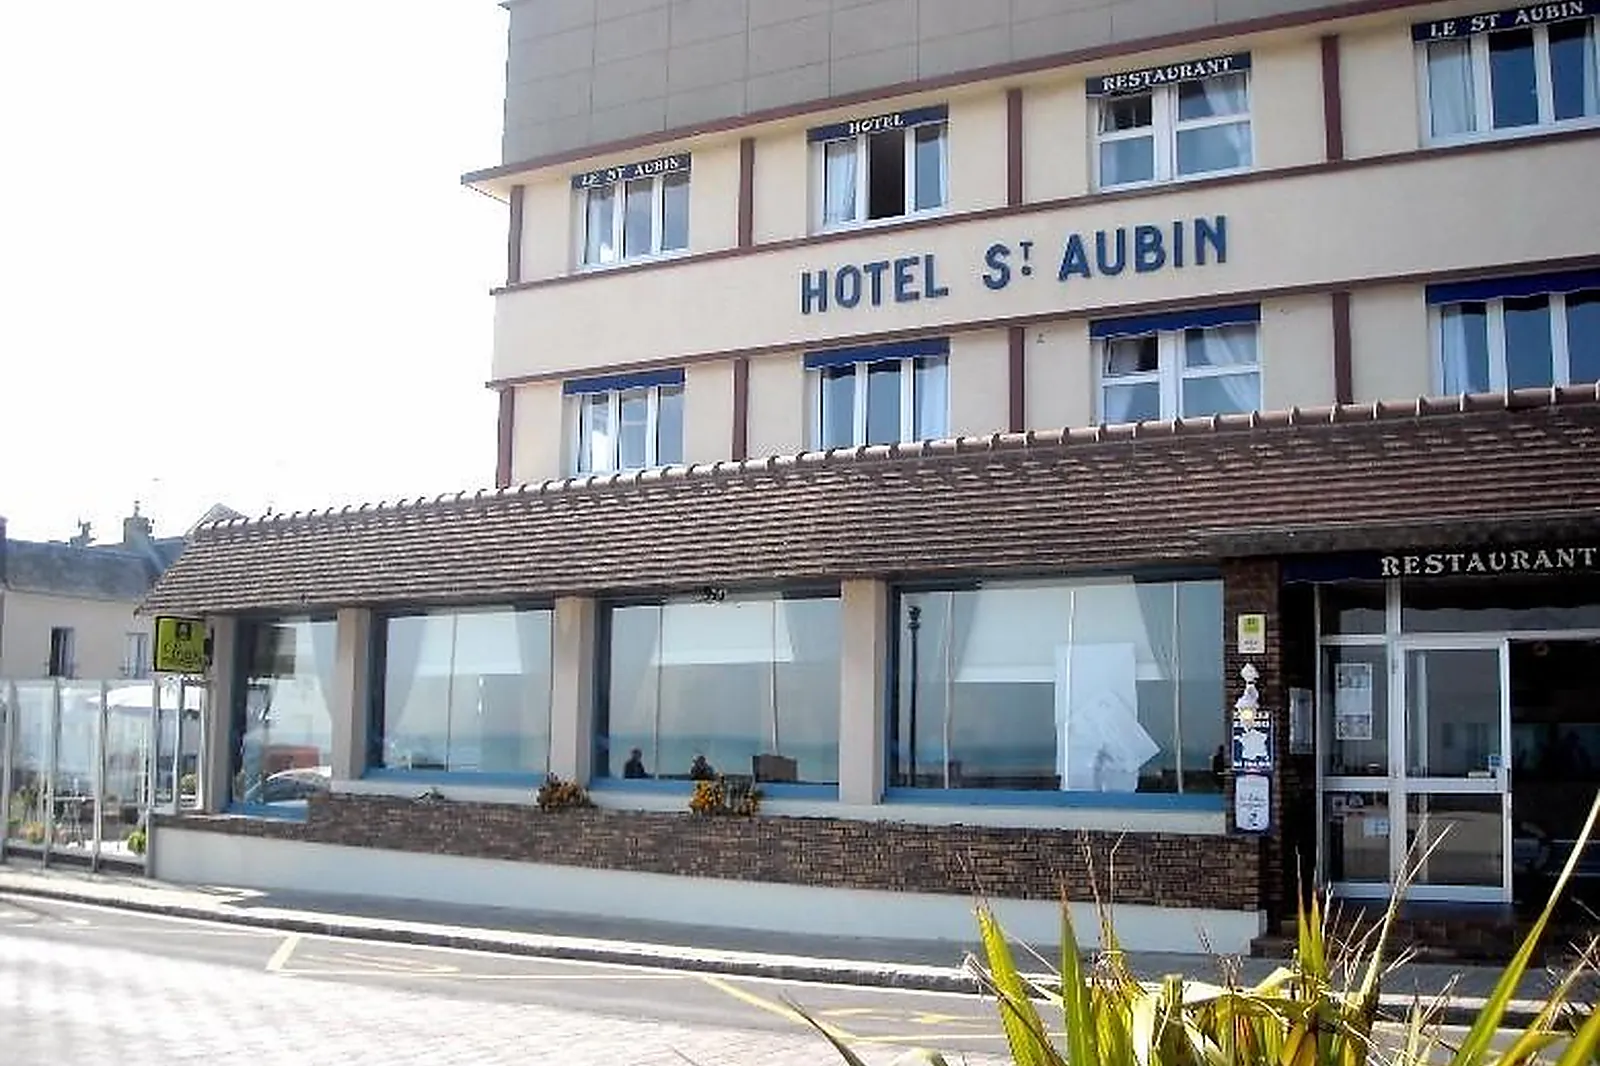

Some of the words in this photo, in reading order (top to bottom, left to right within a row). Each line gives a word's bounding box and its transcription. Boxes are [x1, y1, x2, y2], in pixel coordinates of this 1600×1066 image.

[1430, 21, 1456, 37] LE
[1470, 14, 1499, 31] ST
[1515, 1, 1583, 25] AUBIN
[1102, 56, 1233, 91] RESTAURANT
[849, 114, 904, 133] HOTEL
[801, 253, 949, 315] HOTEL
[1057, 215, 1227, 282] AUBIN
[1380, 547, 1597, 576] RESTAURANT
